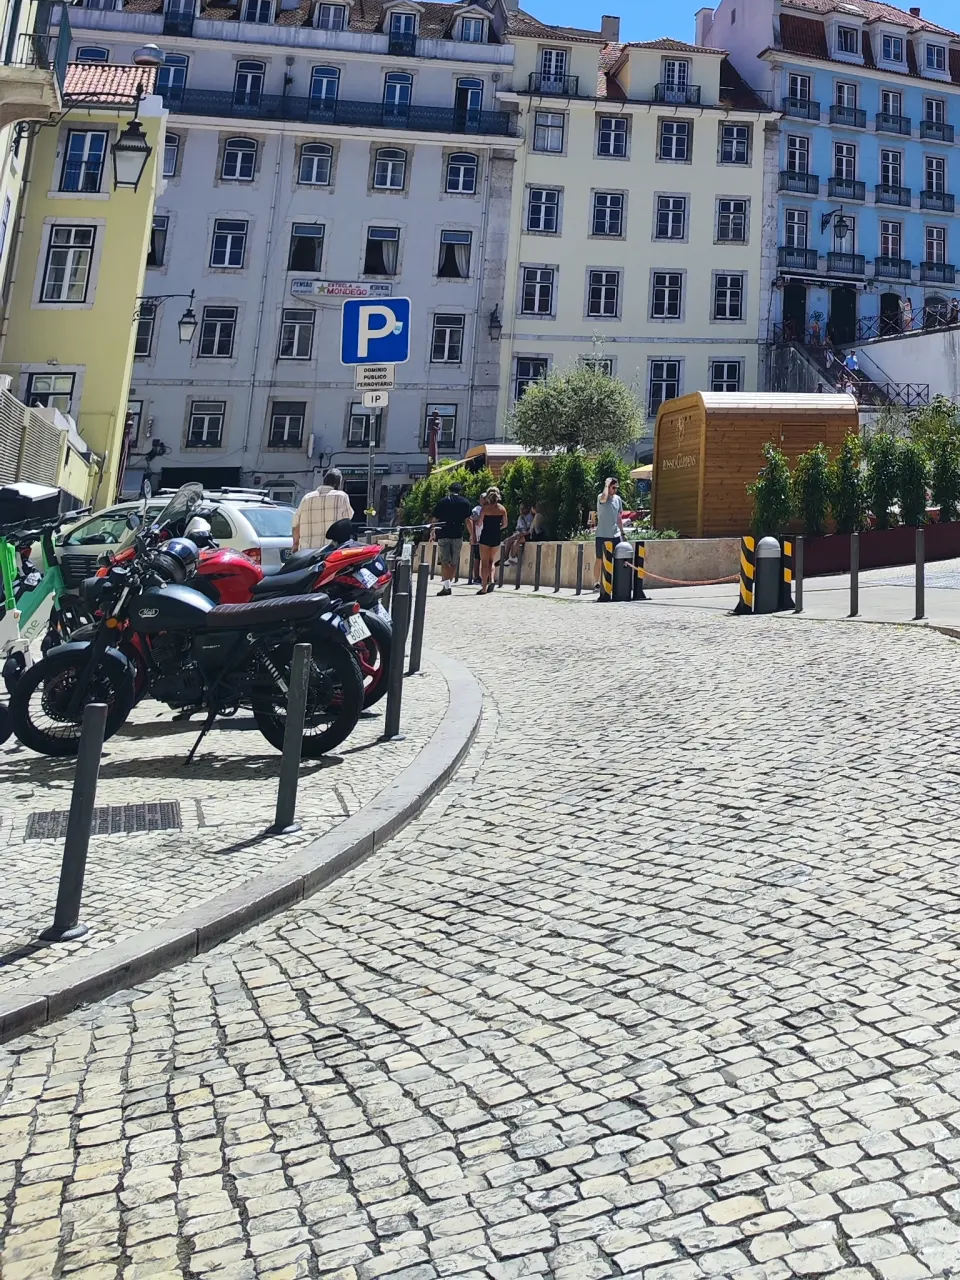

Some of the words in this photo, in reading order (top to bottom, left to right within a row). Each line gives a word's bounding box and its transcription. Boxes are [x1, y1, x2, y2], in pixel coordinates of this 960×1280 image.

[326, 288, 368, 296] MONDEGO
[357, 305, 397, 358] P
[371, 395, 381, 403] IP
